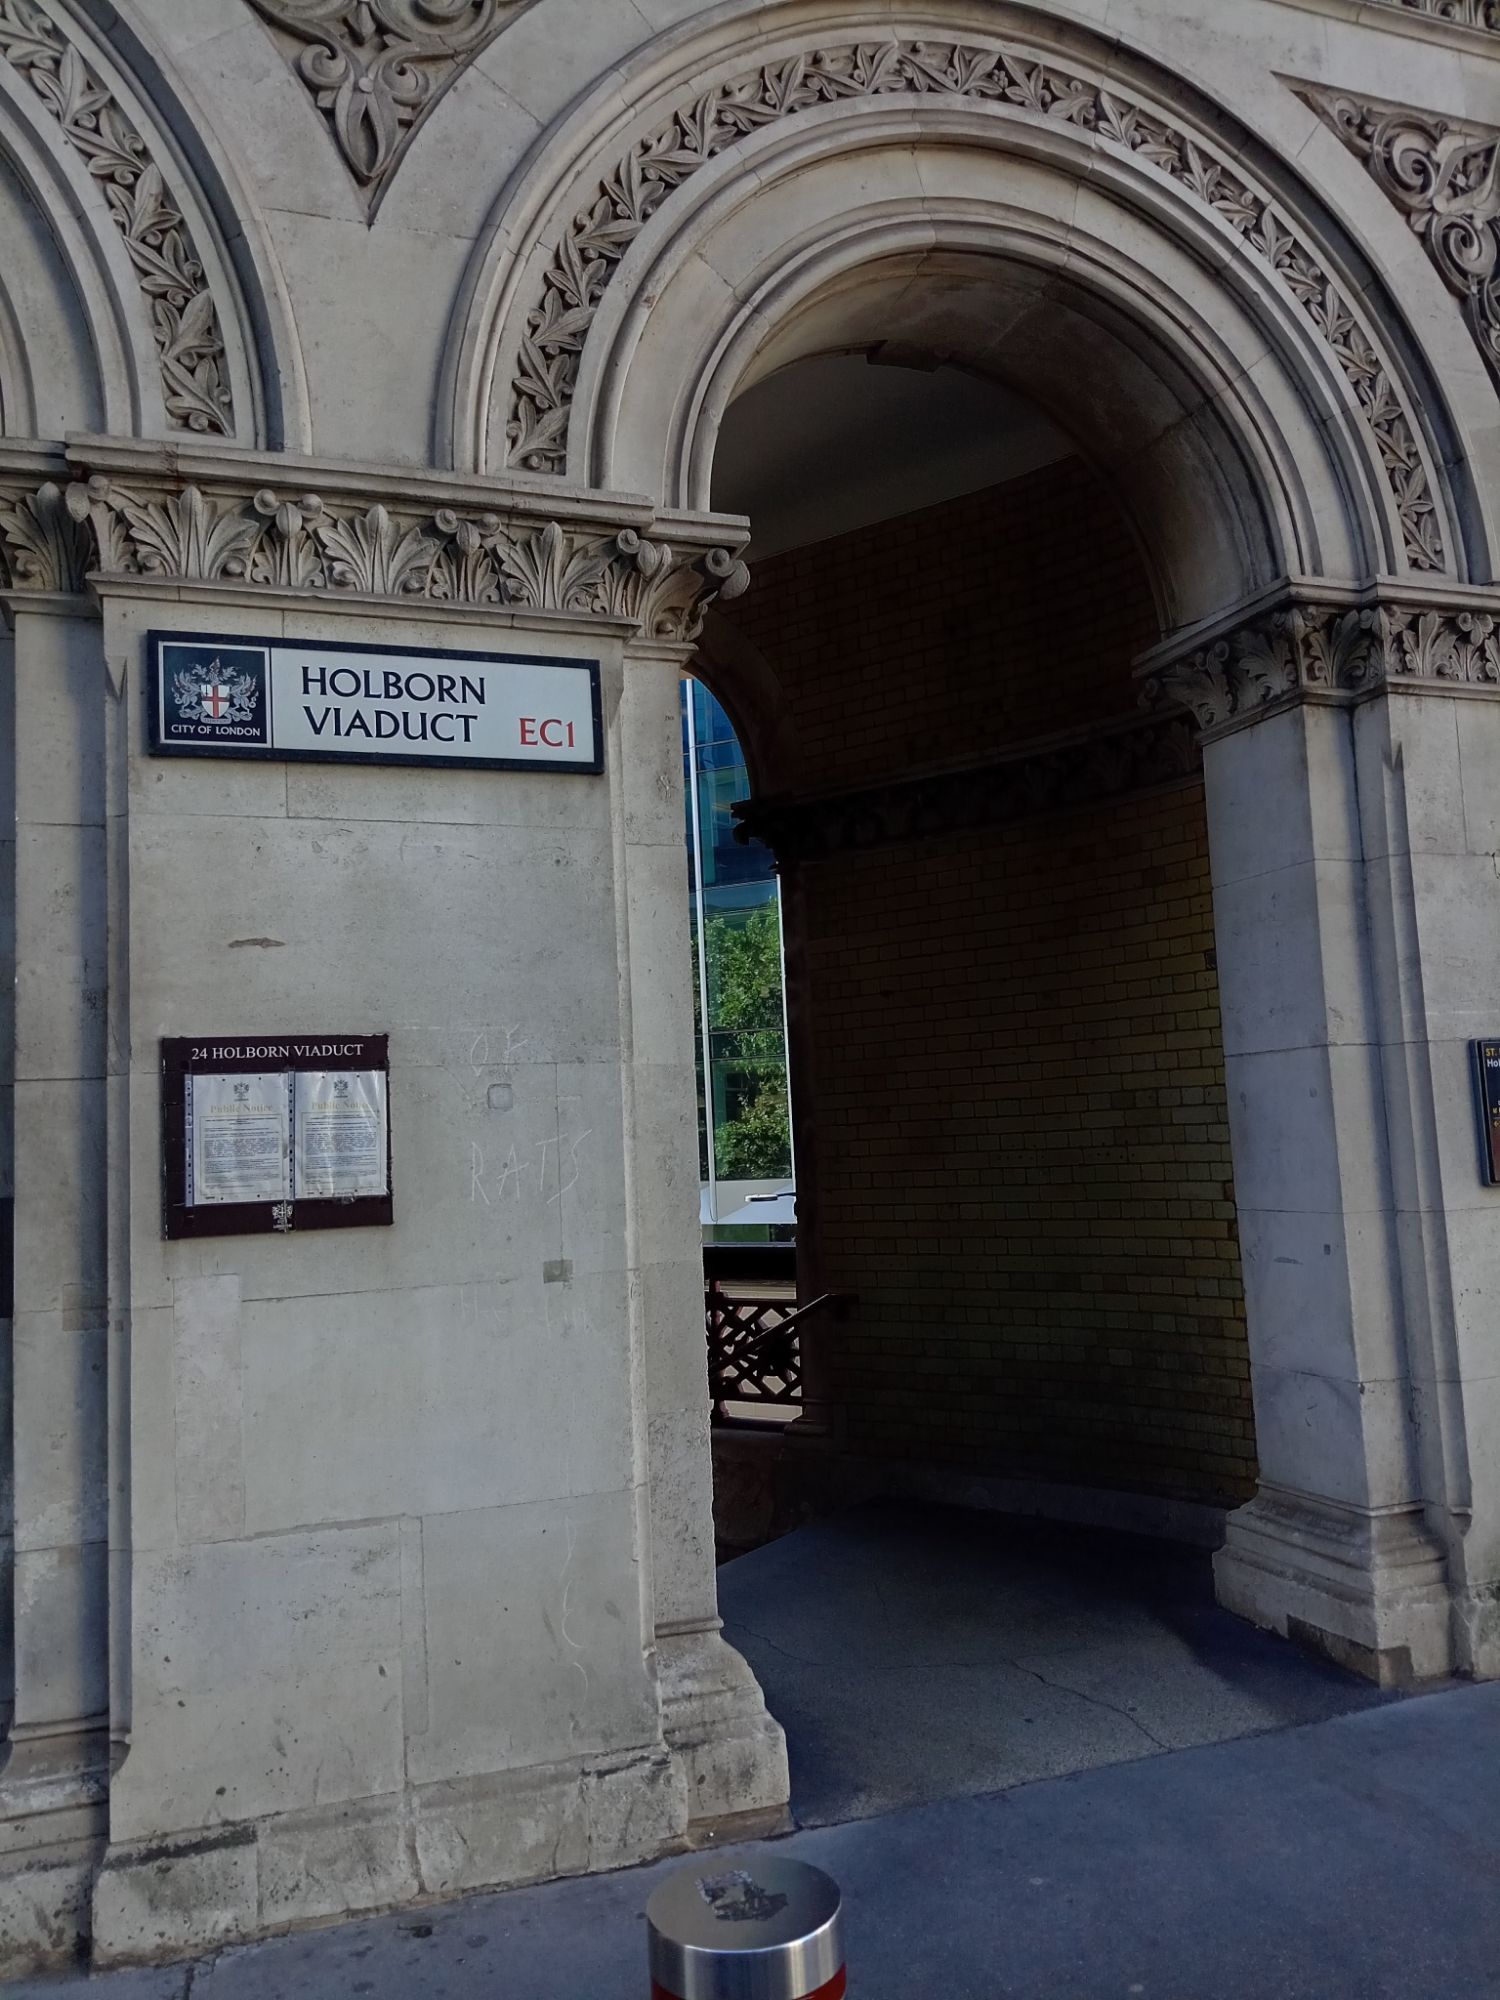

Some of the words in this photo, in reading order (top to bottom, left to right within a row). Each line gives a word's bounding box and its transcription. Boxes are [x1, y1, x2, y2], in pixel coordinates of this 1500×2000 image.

[302, 666, 486, 704] HOLBORN
[171, 724, 196, 734] CITY
[198, 725, 212, 735] OF
[215, 726, 261, 737] LONDON
[303, 706, 478, 743] VIADUCT
[519, 718, 575, 748] EC1
[191, 1047, 208, 1060] 24
[213, 1046, 290, 1060] HOLBORN
[294, 1044, 364, 1057] VIADUCT
[471, 1129, 593, 1205] RATS
